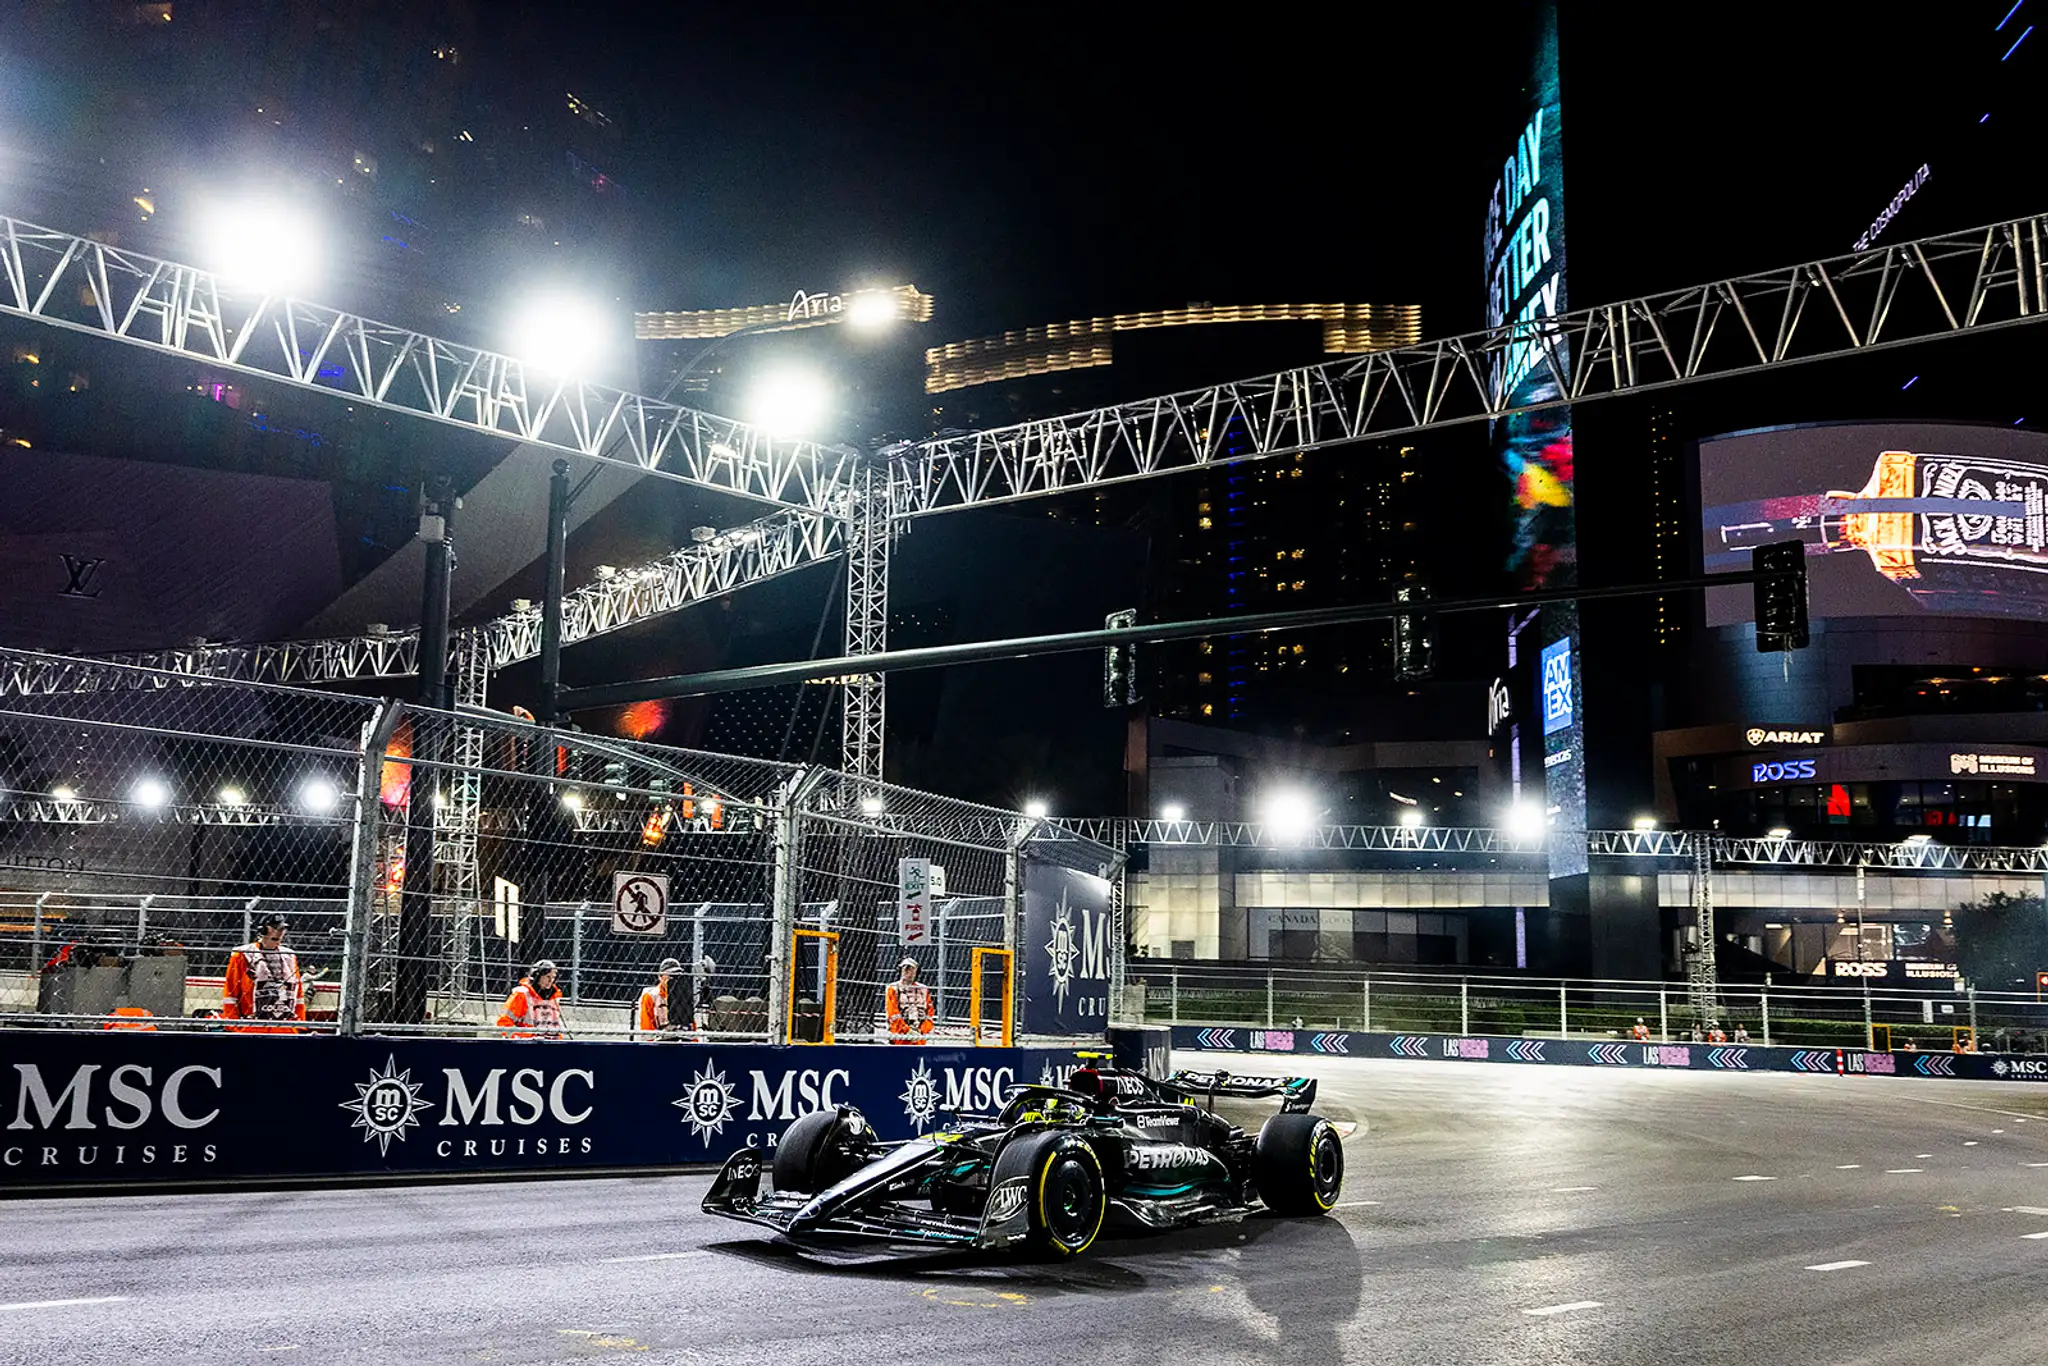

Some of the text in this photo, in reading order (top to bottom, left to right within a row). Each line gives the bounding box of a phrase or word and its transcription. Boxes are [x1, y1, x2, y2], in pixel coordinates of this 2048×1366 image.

[1504, 107, 1543, 226] DAY
[1870, 163, 1931, 240] COSMOPOLITA
[787, 290, 841, 321] Aria
[1763, 731, 1825, 744] ARIAT
[904, 923, 925, 931] FIRE
[1268, 914, 1317, 925] CANADA
[1835, 962, 1888, 977] ROSS
[1078, 997, 1106, 1016] CRU
[1443, 1039, 1459, 1057] LAS
[1643, 1046, 1659, 1064] LAS
[1847, 1053, 1864, 1072] LAS
[2010, 1060, 2047, 1074] MSC
[7, 1064, 222, 1130] MSC
[438, 1068, 594, 1126] MSC
[747, 1069, 850, 1121] MSC
[940, 1067, 1014, 1111] MSC
[1145, 1115, 1180, 1128] TeamViewer
[437, 1138, 592, 1157] CRUISES
[746, 1133, 778, 1147] CR
[3, 1145, 217, 1166] CRUISES
[1125, 1147, 1210, 1169] PETRONAS
[727, 1164, 760, 1181] INEOS
[1000, 1185, 1028, 1208] IWC
